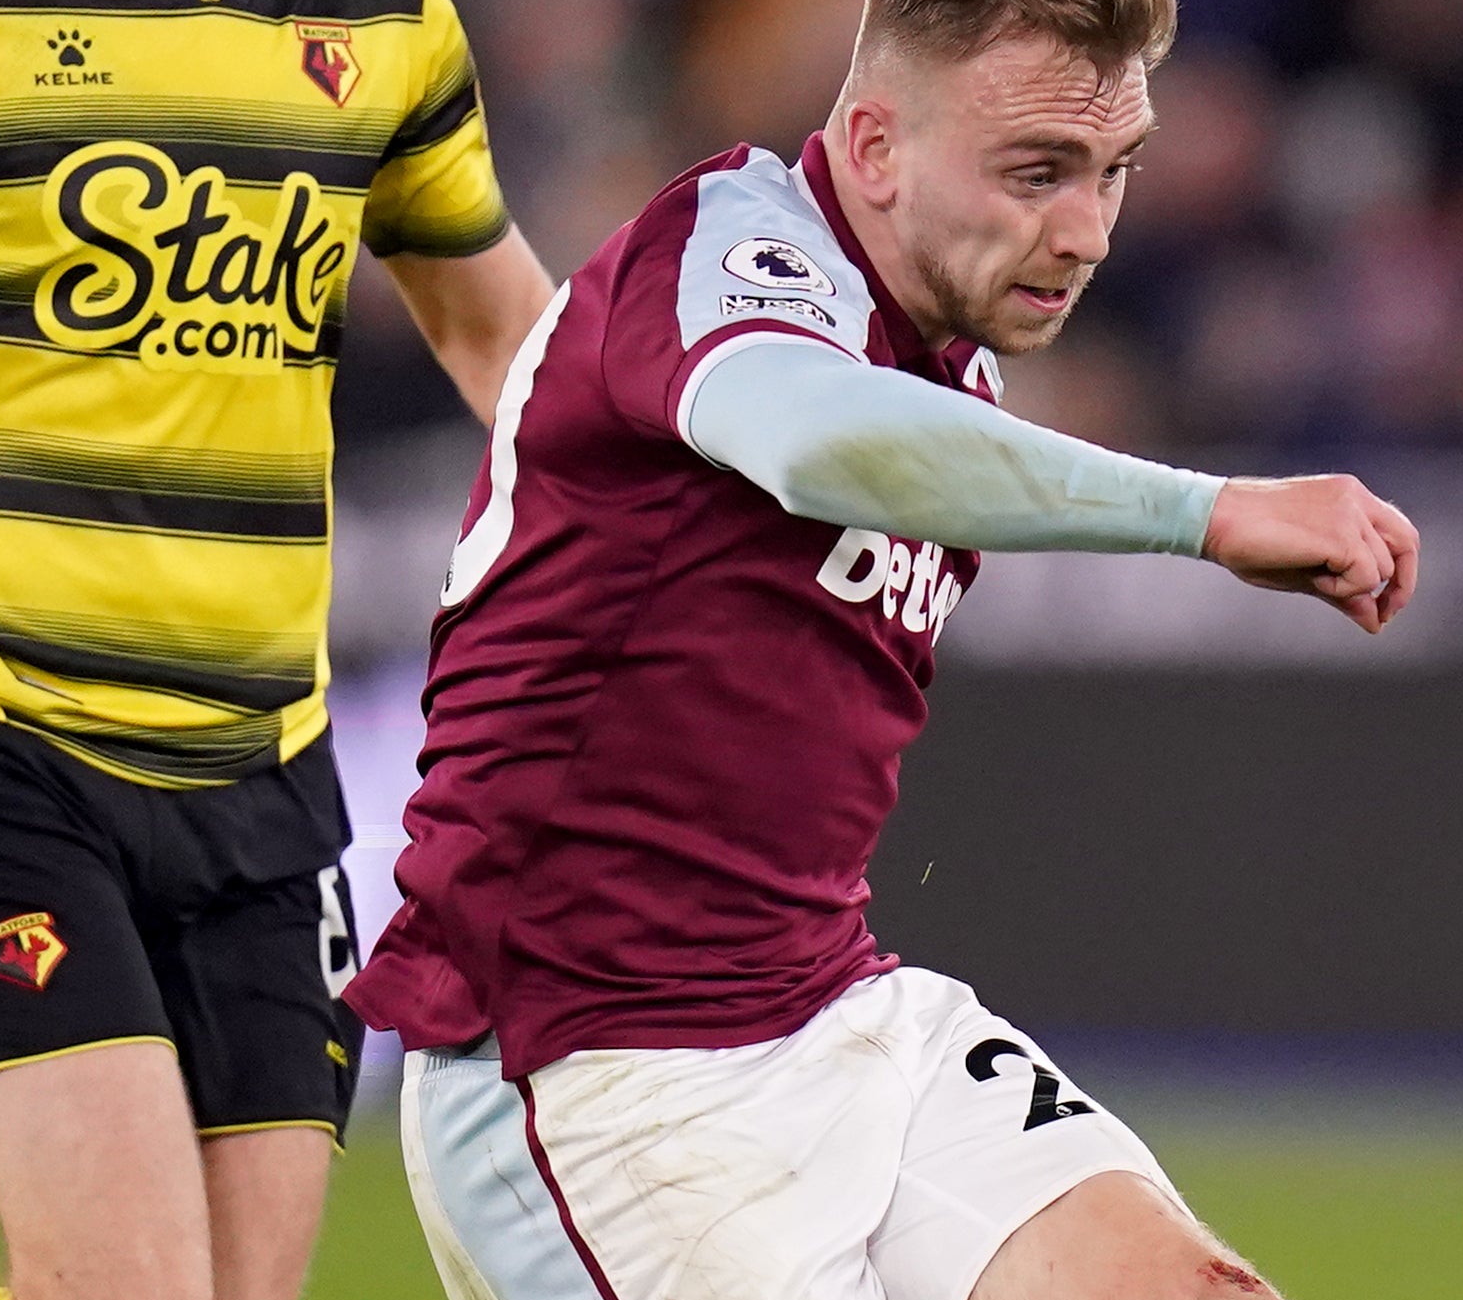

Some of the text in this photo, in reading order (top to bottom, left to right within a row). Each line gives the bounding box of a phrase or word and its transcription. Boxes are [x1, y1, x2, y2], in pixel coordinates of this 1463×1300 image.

[34, 72, 114, 87] KELME
[52, 154, 346, 334] Stake
[155, 319, 277, 359] .com
